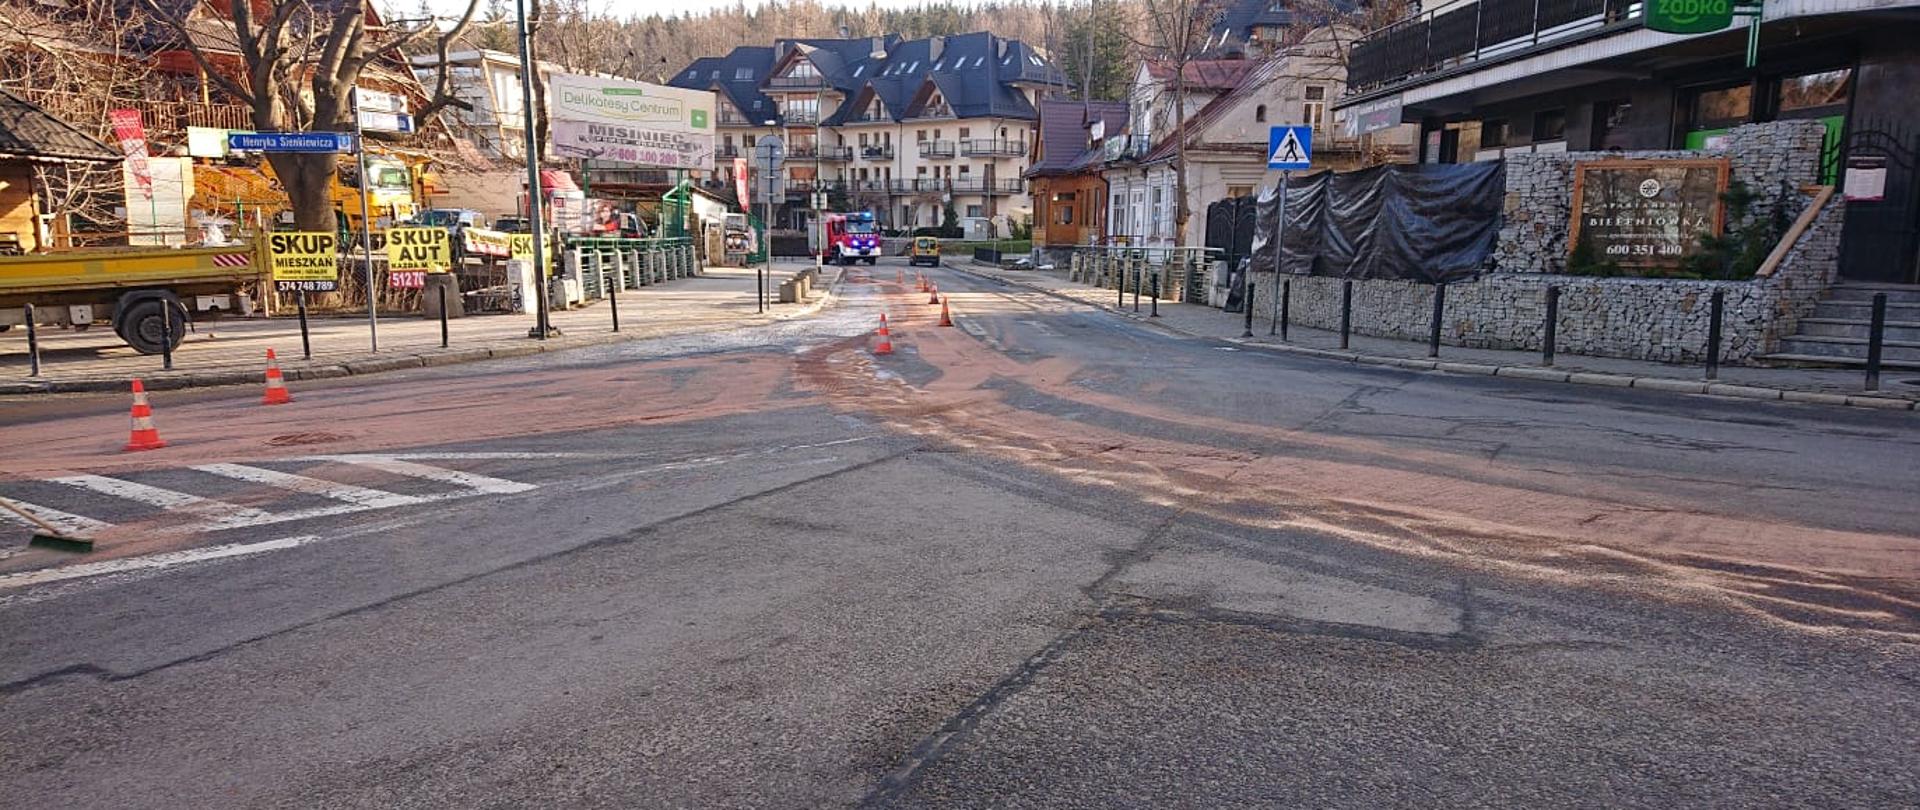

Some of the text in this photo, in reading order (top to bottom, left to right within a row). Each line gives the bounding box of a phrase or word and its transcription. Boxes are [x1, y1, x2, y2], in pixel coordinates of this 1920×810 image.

[564, 91, 629, 113] Delikatesy
[631, 99, 680, 115] Centrum
[242, 136, 334, 148] Henryka Sienkiewicza
[271, 235, 333, 254] SKUP
[391, 230, 446, 246] SKUP
[399, 246, 441, 261] AUT
[1606, 244, 1682, 255] 600 351 400
[275, 254, 333, 267] MIESZKAŃ
